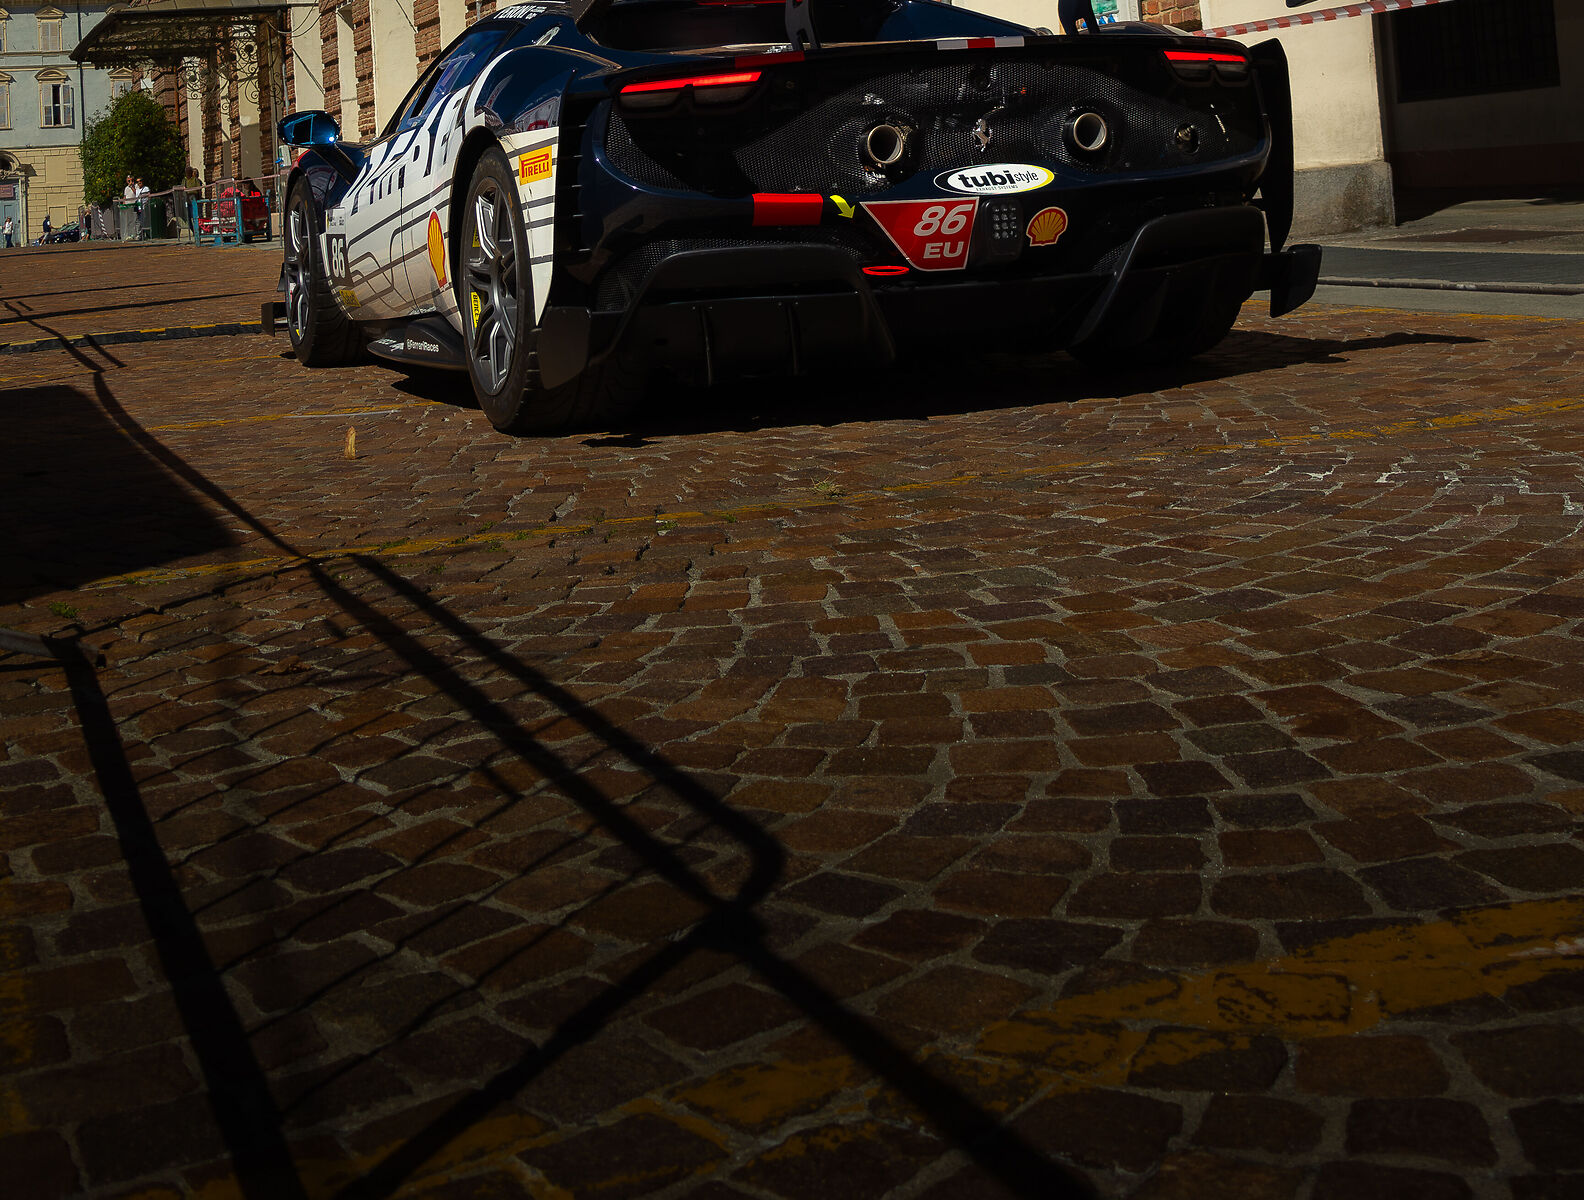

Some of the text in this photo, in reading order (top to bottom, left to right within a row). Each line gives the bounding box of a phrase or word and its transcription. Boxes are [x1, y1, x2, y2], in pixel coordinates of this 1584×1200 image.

[521, 153, 549, 178] PIRELLI
[958, 170, 1039, 188] tubi style
[913, 203, 975, 237] 86
[331, 237, 346, 279] 86
[922, 241, 965, 259] EU
